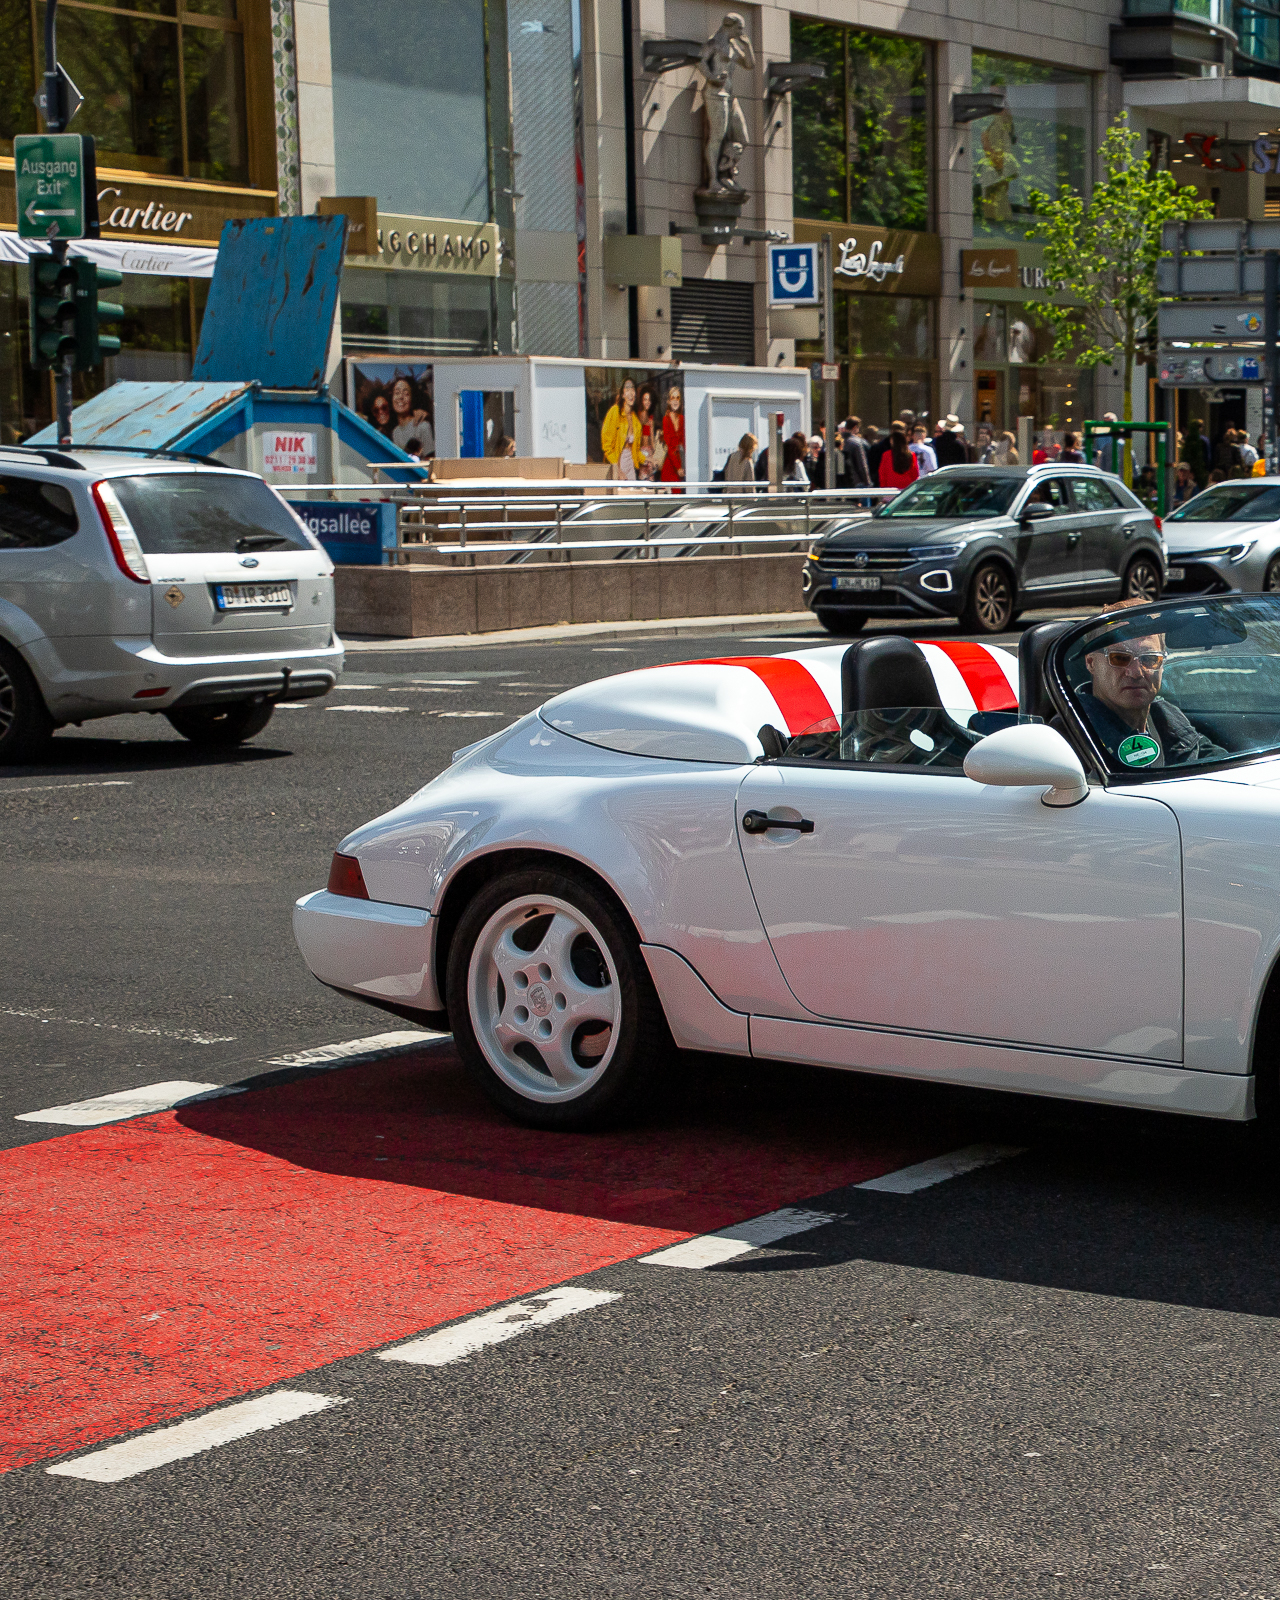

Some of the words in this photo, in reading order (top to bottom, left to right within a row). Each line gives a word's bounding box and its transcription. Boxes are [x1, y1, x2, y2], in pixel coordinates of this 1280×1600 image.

[21, 158, 78, 178] Ausgang
[37, 180, 62, 196] Exit
[97, 187, 193, 232] Cartier
[121, 249, 174, 271] Cartier
[275, 437, 305, 453] NIK
[224, 587, 234, 604] D
[1132, 738, 1143, 750] 4
